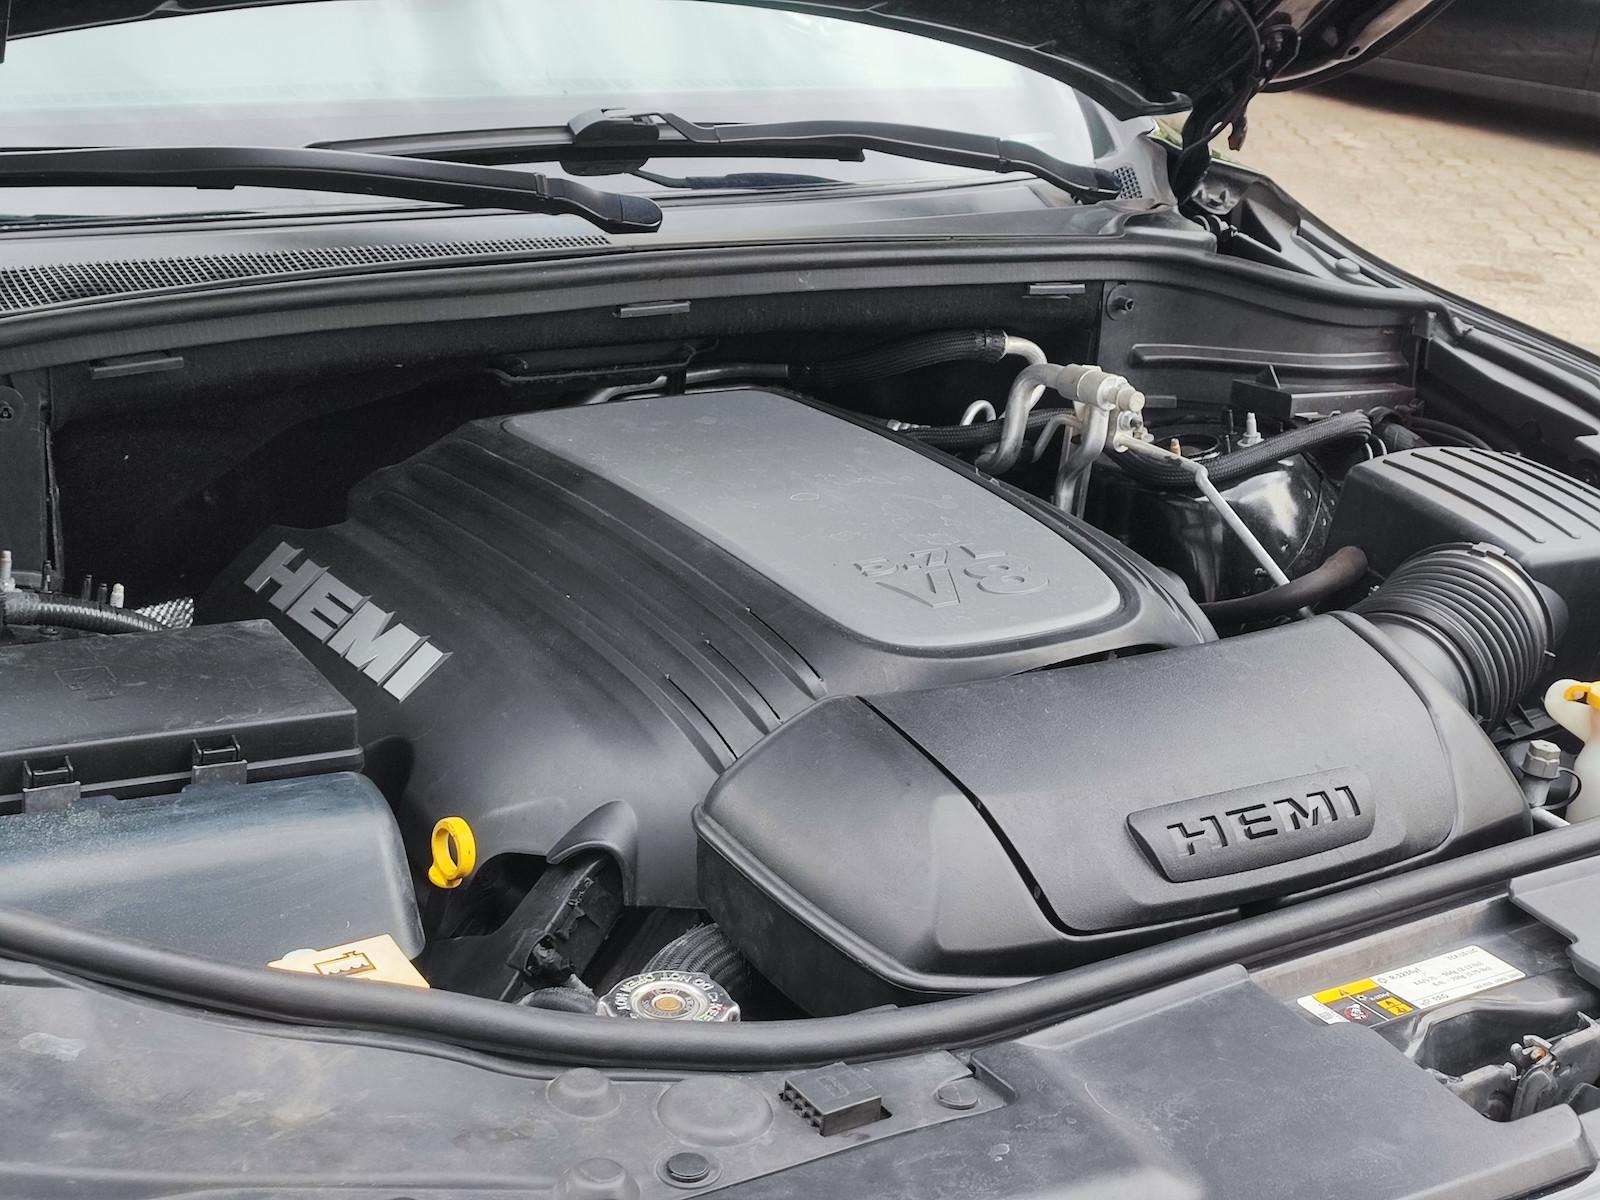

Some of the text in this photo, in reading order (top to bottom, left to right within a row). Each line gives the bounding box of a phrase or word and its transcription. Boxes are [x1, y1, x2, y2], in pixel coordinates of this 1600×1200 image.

[876, 561, 1050, 608] V8
[244, 541, 454, 703] HEMI
[1166, 785, 1361, 857] HEMI
[660, 972, 692, 982] NOT
[692, 977, 714, 991] DO
